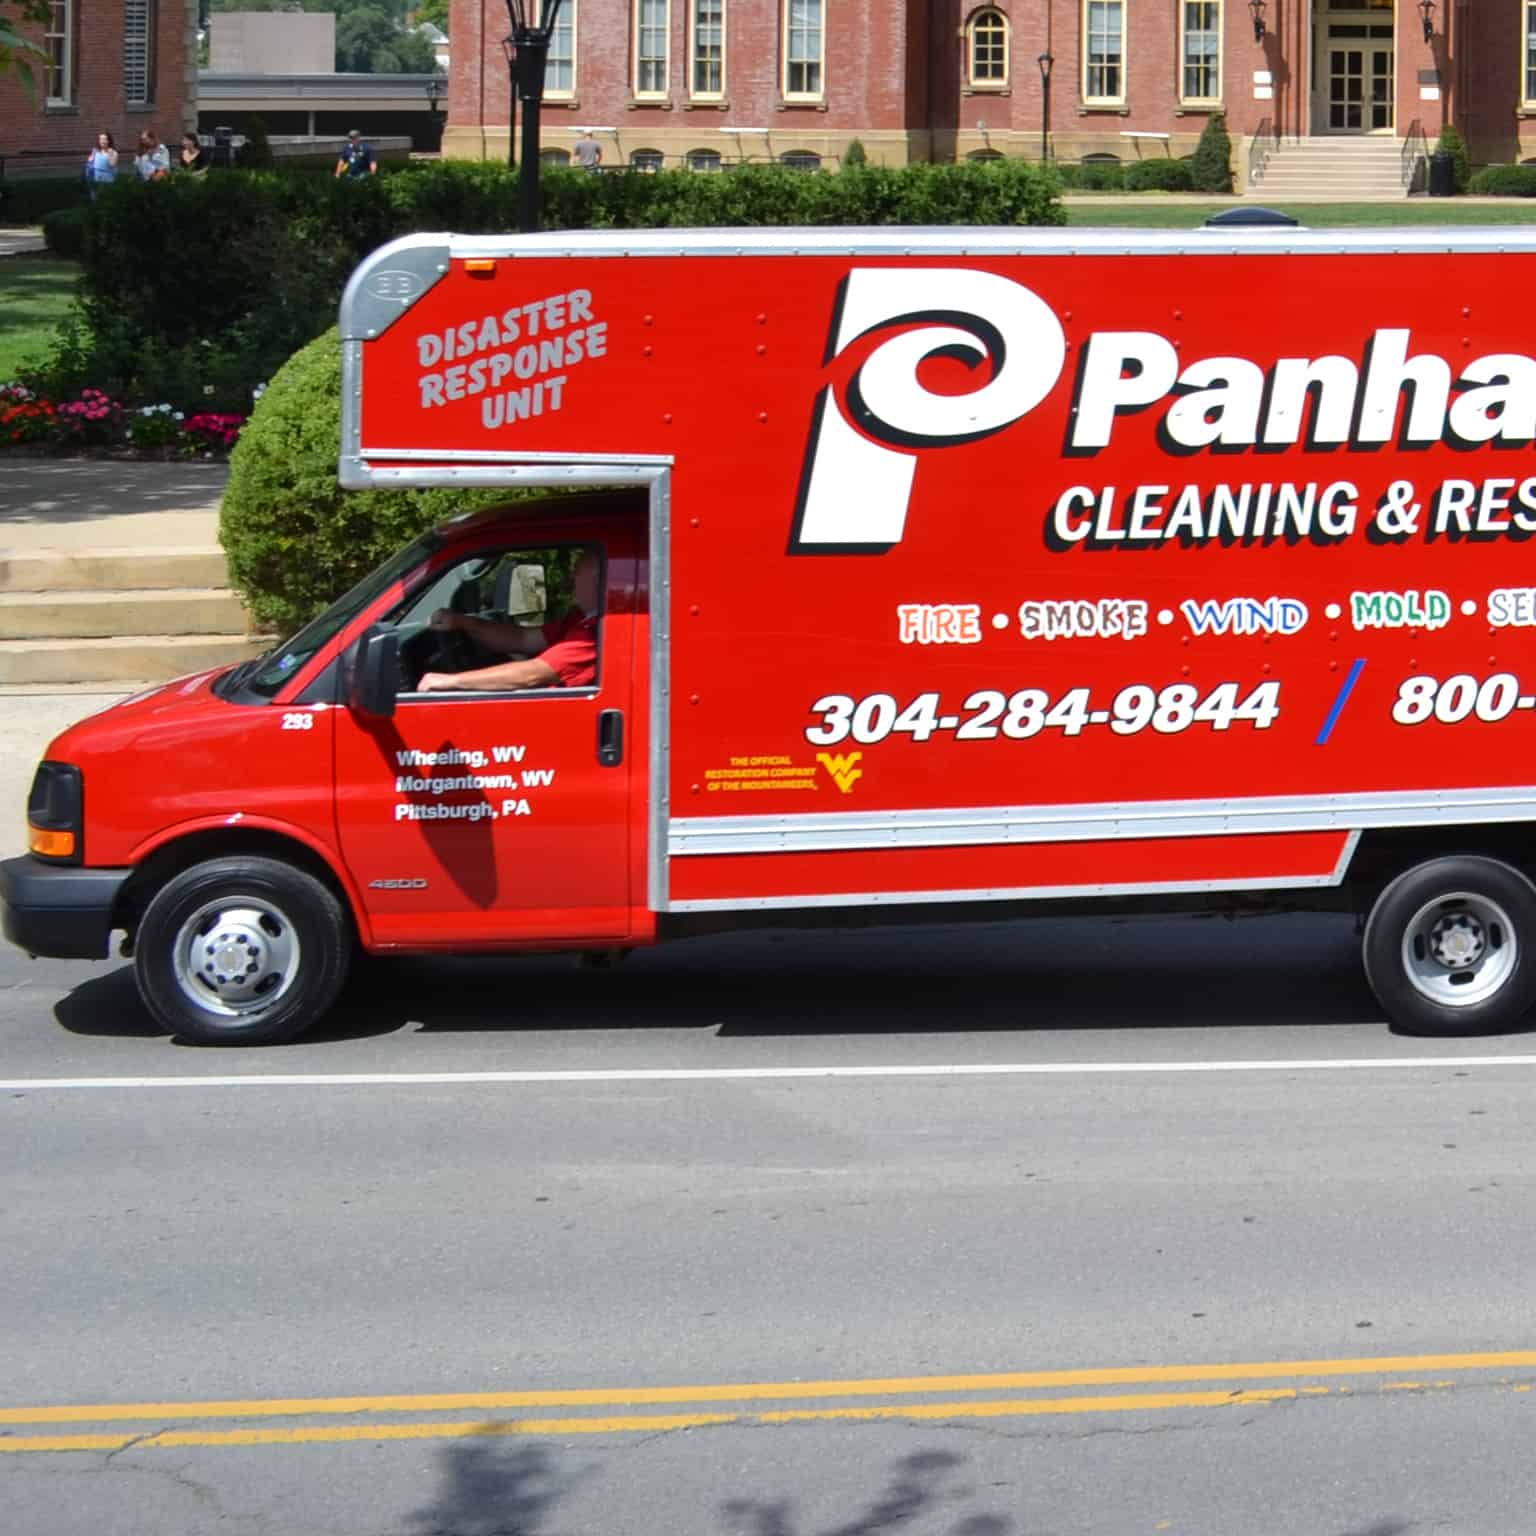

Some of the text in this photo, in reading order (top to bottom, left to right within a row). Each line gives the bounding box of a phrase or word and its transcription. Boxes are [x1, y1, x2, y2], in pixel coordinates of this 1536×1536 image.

[417, 288, 594, 367] DISASTER
[418, 322, 608, 409] RESPONSE
[482, 375, 568, 430] UNIT
[1053, 481, 1360, 543] CLEANING
[1375, 479, 1422, 536] &
[897, 603, 982, 645] FIRE
[1018, 598, 1149, 641] SMOKE
[1179, 596, 1309, 637] WIND
[1349, 589, 1452, 631] MOLD
[804, 681, 1281, 745] 304-284-9844
[395, 768, 555, 795] Morgantown, WV
[396, 745, 526, 769] Wheeling, WV
[395, 798, 532, 822] Pittsburgh, PA
